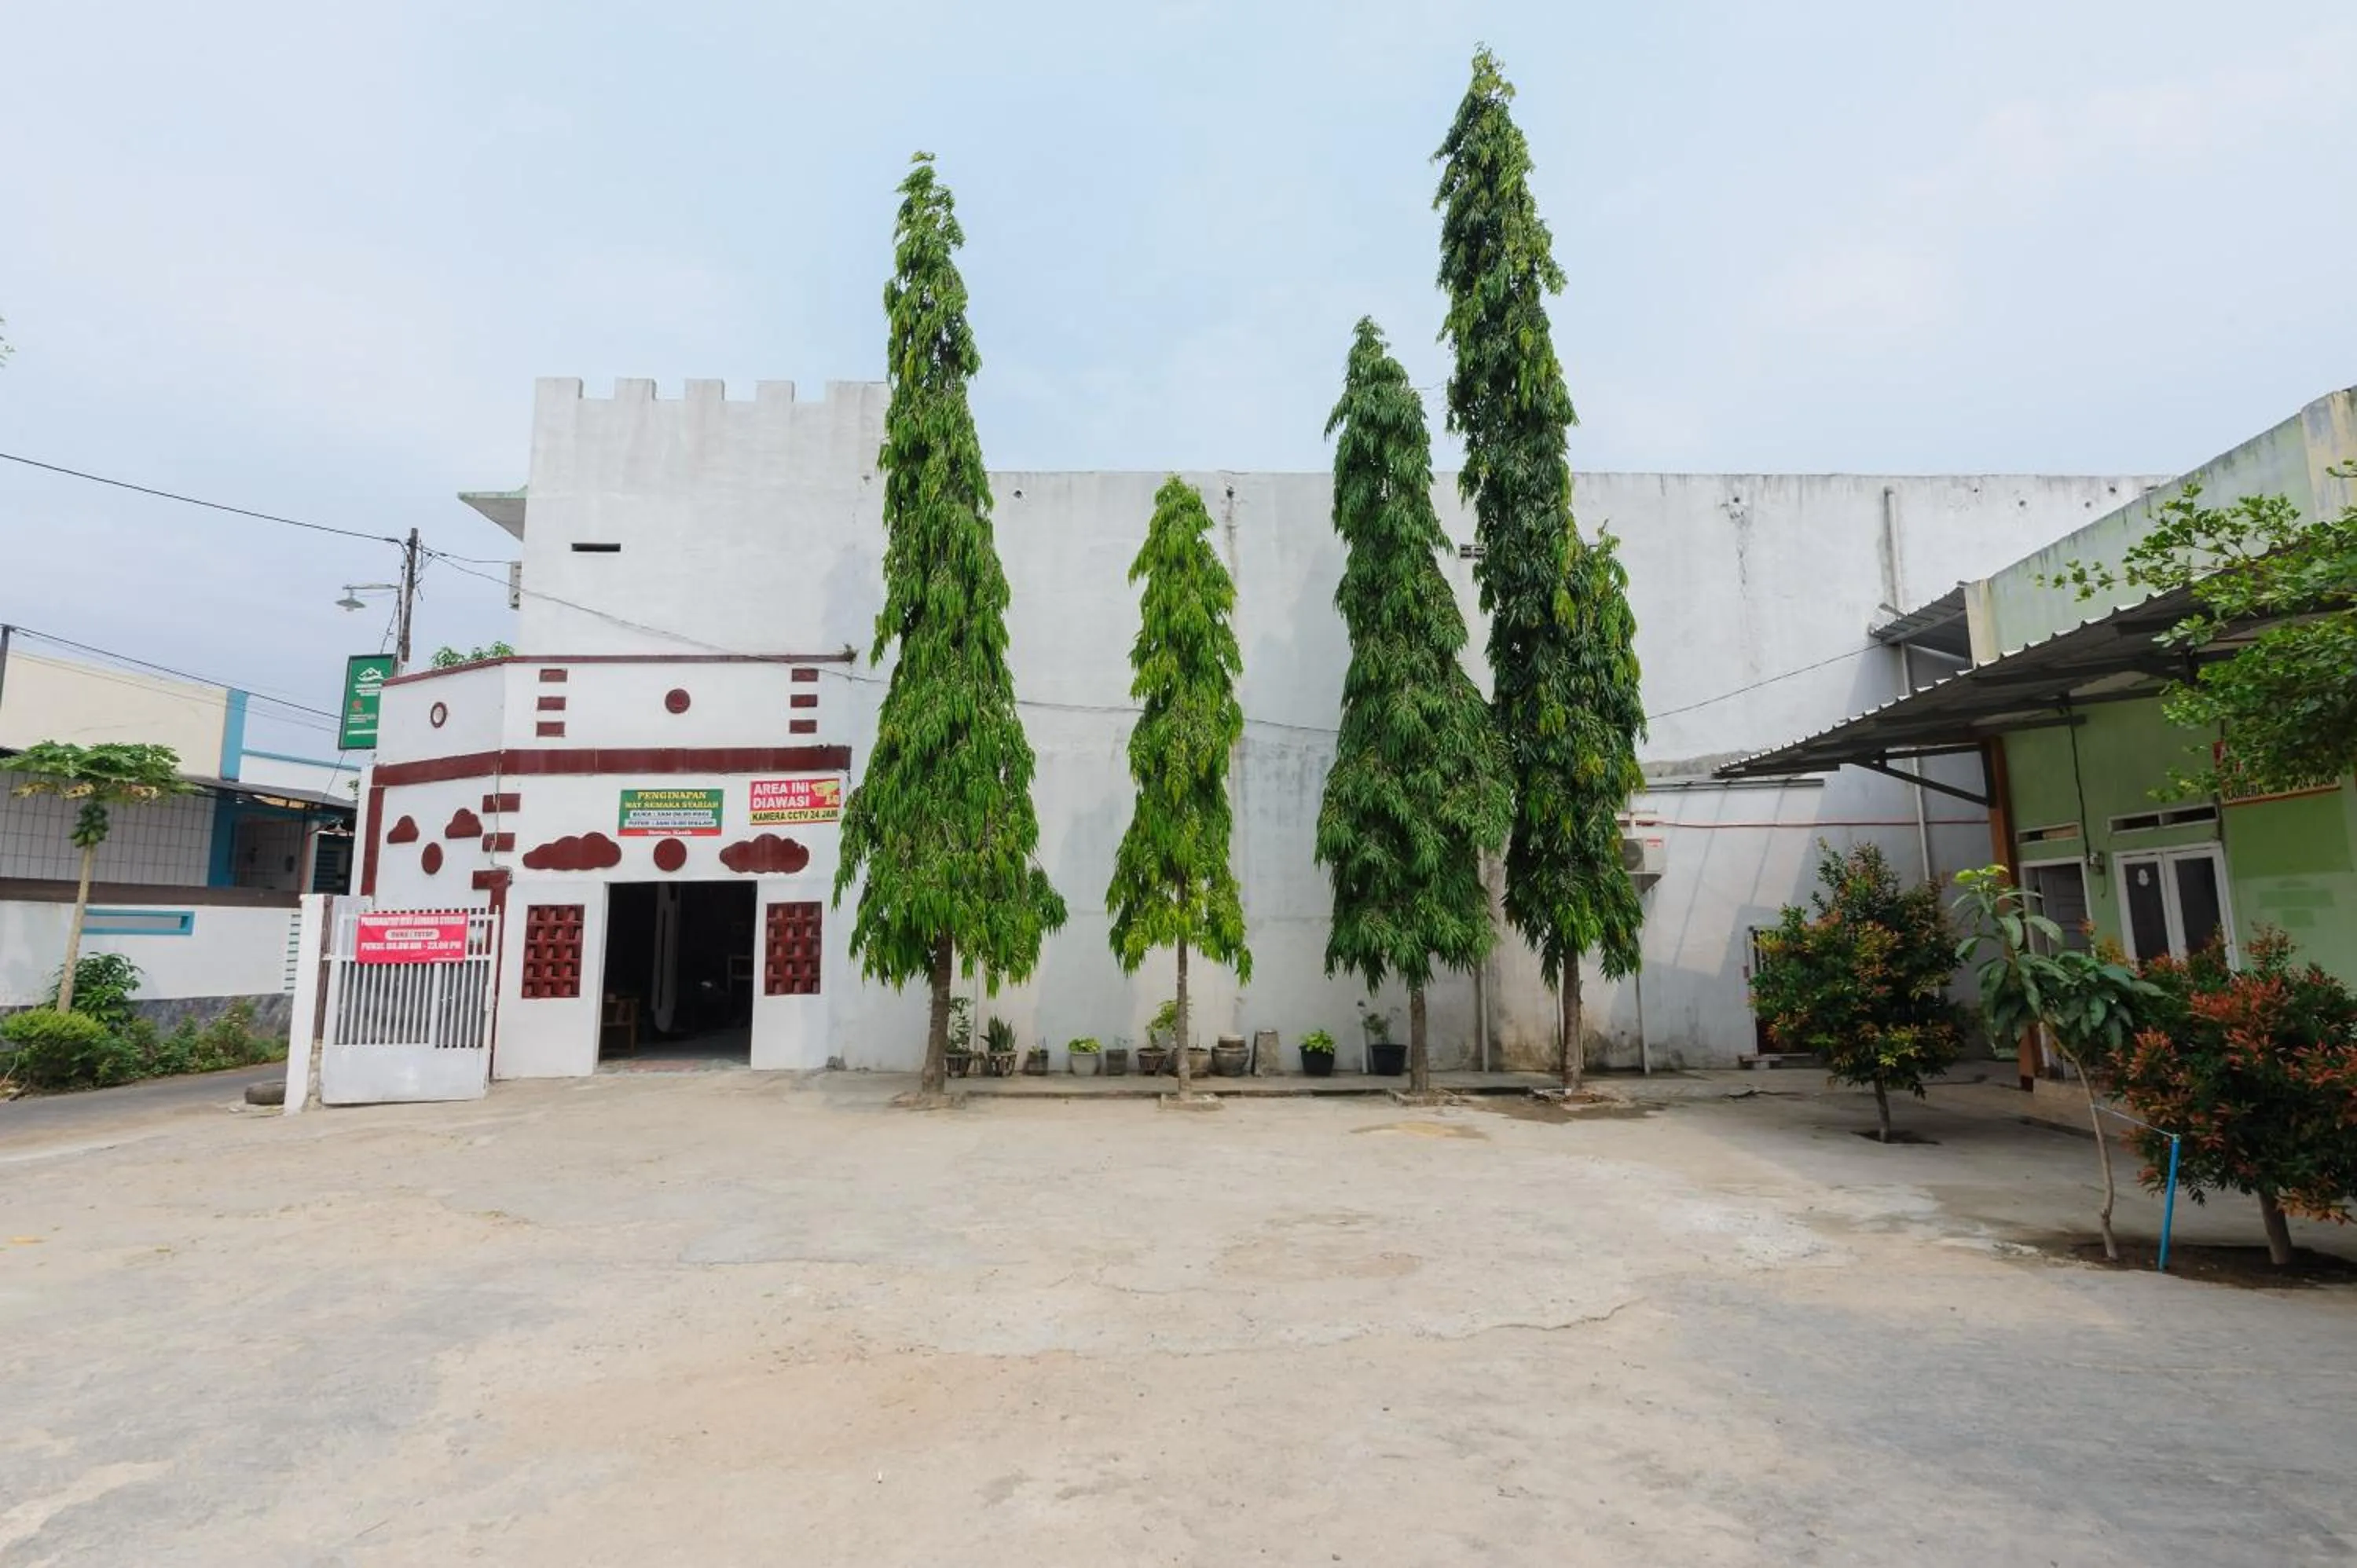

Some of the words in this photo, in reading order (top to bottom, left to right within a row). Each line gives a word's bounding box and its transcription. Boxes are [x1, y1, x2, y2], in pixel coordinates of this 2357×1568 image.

[753, 782, 787, 795] AREA
[791, 781, 809, 793] INI
[637, 791, 706, 800] PENGINAPAN
[753, 794, 810, 808] DIAWASI
[752, 811, 786, 821] KAMERA
[787, 811, 808, 819] CCTV
[810, 810, 819, 819] 24
[821, 809, 838, 818] JAM
